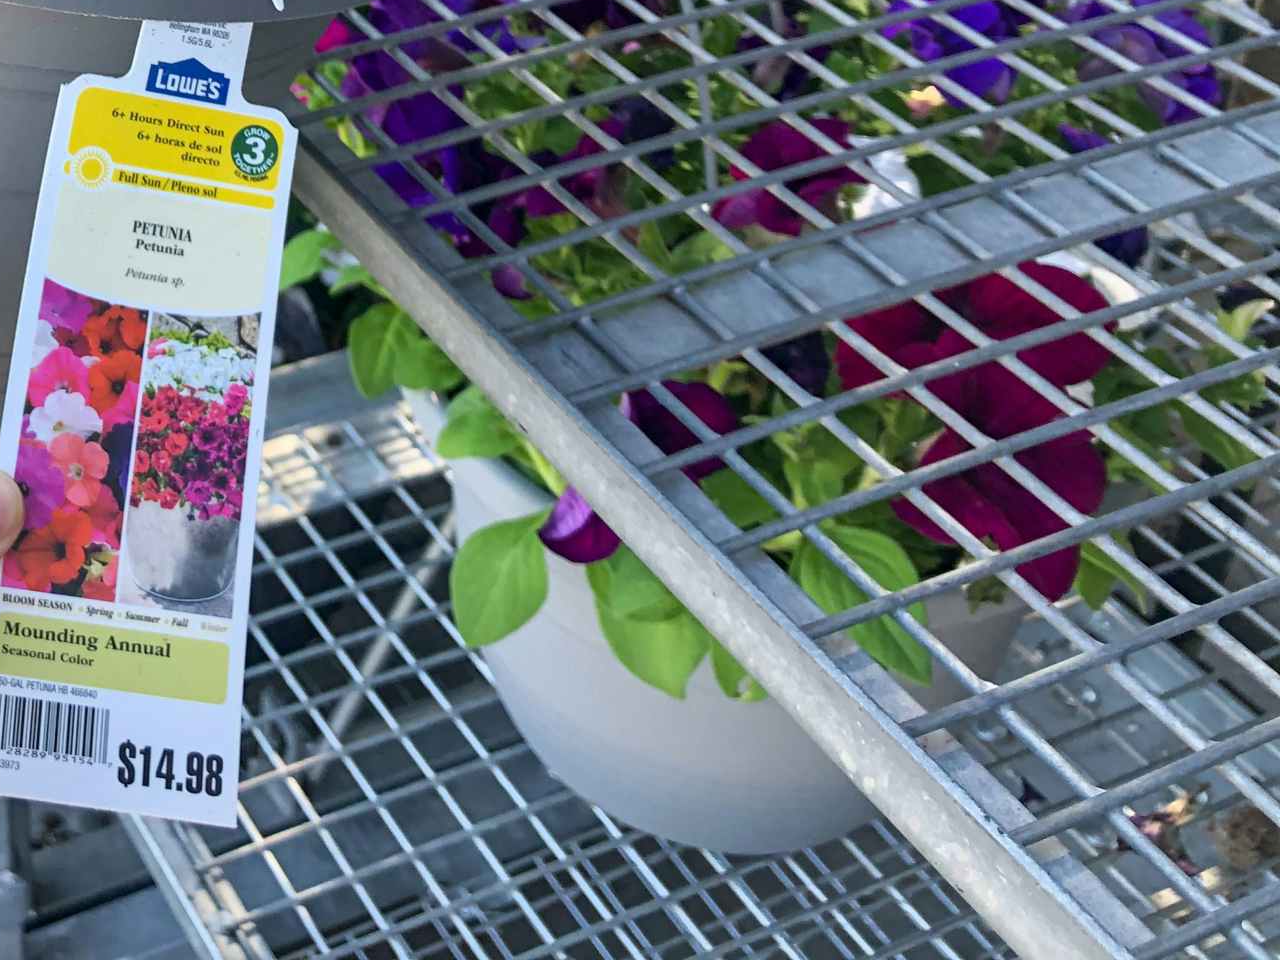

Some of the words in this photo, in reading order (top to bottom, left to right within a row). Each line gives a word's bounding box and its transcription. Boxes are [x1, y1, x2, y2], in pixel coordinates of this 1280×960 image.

[155, 69, 222, 100] LOWE'S
[112, 108, 126, 119] 6+
[129, 111, 163, 127] Hours
[167, 117, 200, 134] Direct
[204, 124, 225, 137] Sun
[244, 127, 270, 141] GROW
[137, 131, 151, 143] 6+
[155, 133, 186, 149] horas
[189, 140, 204, 152] de
[207, 142, 222, 154] sol
[242, 137, 266, 165] 3
[181, 151, 220, 167] directo
[118, 171, 139, 186] Full
[141, 176, 161, 189] Sun
[171, 180, 200, 196] Pleno
[202, 186, 217, 198] sol
[132, 220, 192, 242] PETUNIA
[135, 239, 185, 257] Petunia
[125, 267, 168, 285] Petunia
[171, 276, 185, 287] sp.
[2, 593, 35, 606] BLOOM
[38, 598, 72, 611] SEASON
[86, 606, 114, 620] Spring
[125, 611, 160, 623] Summer
[171, 617, 188, 628] Fall
[3, 620, 98, 650] Mounding
[105, 634, 171, 658] Annual
[1, 643, 56, 662] Seasonal
[60, 652, 95, 666] Color
[26, 680, 56, 693] PETUNIA
[6, 747, 47, 759] 28289
[54, 752, 93, 765] 95154
[117, 739, 224, 797] $14.98
